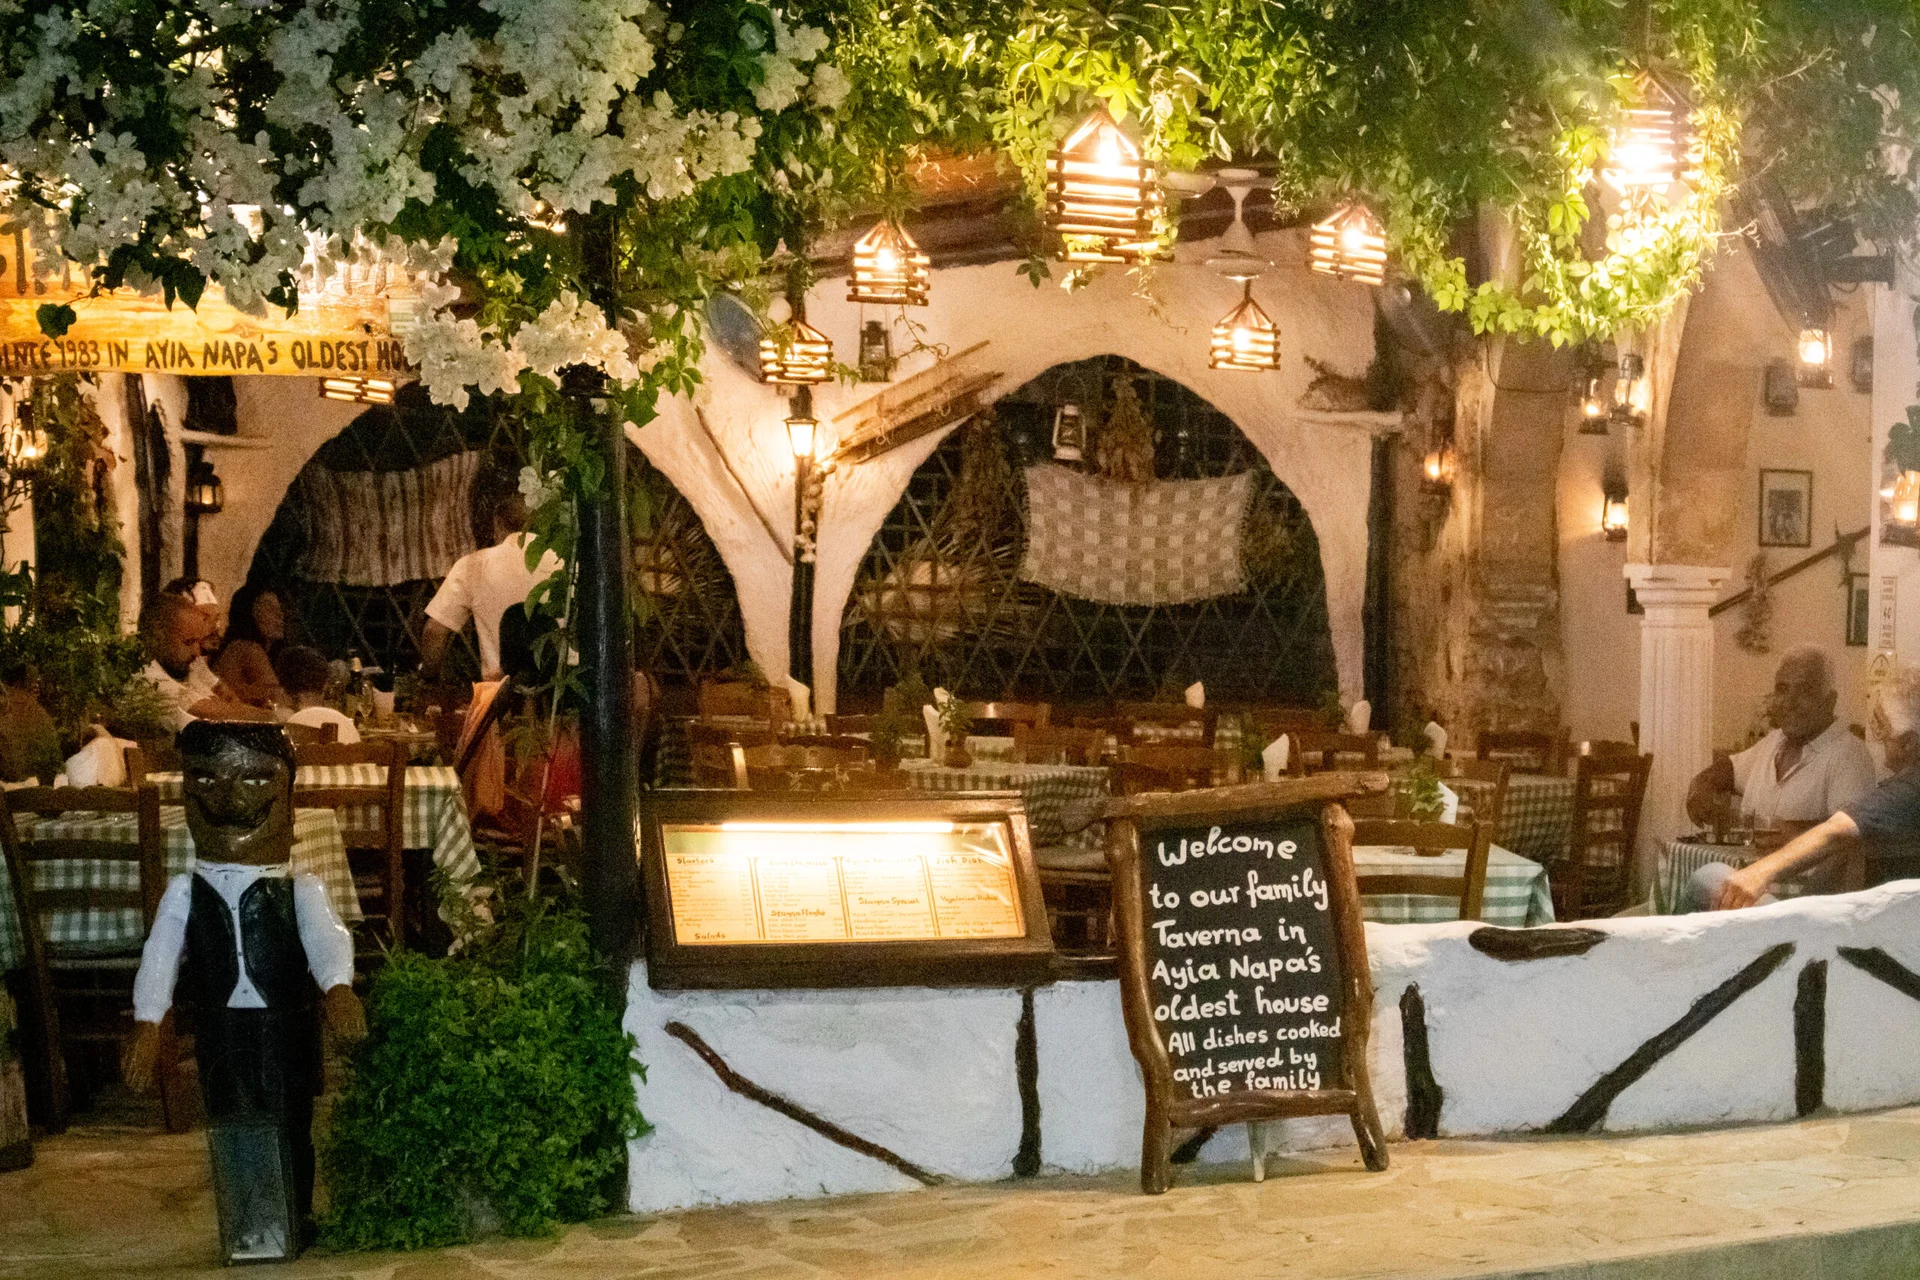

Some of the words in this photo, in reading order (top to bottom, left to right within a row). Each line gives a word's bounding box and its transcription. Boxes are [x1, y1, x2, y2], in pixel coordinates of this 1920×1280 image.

[0, 340, 52, 372] INCE
[58, 339, 101, 368] 1983
[107, 339, 129, 367] IN
[145, 339, 195, 369] AYIA
[203, 334, 278, 372] NAPA'S
[291, 340, 369, 371] OLDEST
[1158, 826, 1297, 867] Welcome
[1149, 884, 1180, 909] to
[1190, 886, 1241, 908] our
[1246, 867, 1329, 911] family
[1152, 919, 1262, 948] Taverna
[1278, 918, 1307, 945] in
[1152, 959, 1221, 990] Ayia
[1230, 947, 1322, 983] Napa's
[1154, 990, 1241, 1021] oldest
[1255, 985, 1329, 1015] house
[1168, 1032, 1196, 1057] All
[1202, 1024, 1268, 1050] dishes
[1277, 1017, 1342, 1041] cooked
[1174, 1059, 1216, 1082] and
[1217, 1048, 1284, 1075] served
[1290, 1047, 1318, 1070] by
[1191, 1078, 1232, 1099] the
[1245, 1070, 1321, 1092] family
